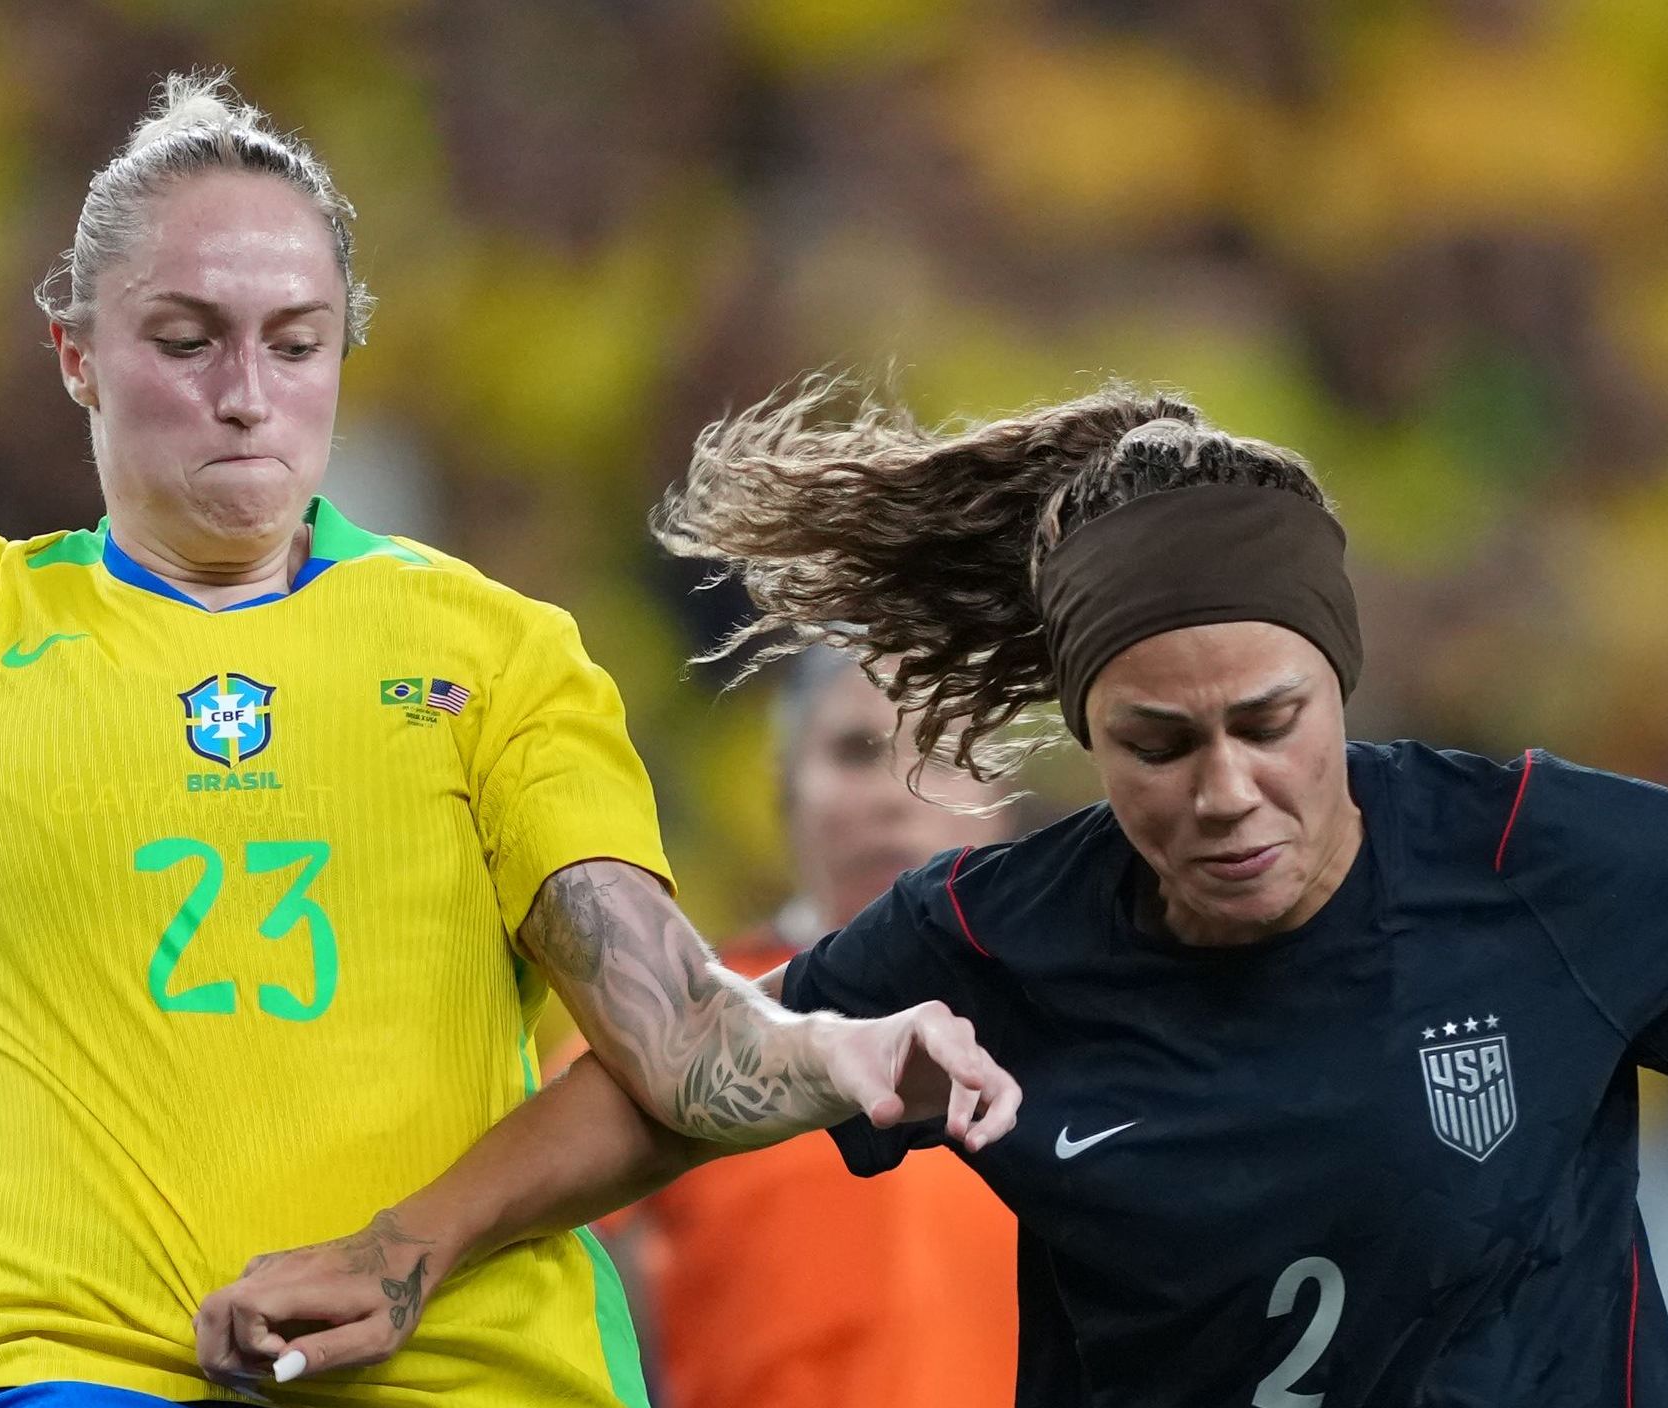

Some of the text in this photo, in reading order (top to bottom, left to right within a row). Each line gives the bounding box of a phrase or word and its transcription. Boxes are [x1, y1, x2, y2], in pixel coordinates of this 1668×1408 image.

[210, 709, 244, 722] CBF
[186, 771, 284, 792] BRASIL
[133, 836, 338, 1022] 23
[1428, 1045, 1503, 1093] USA
